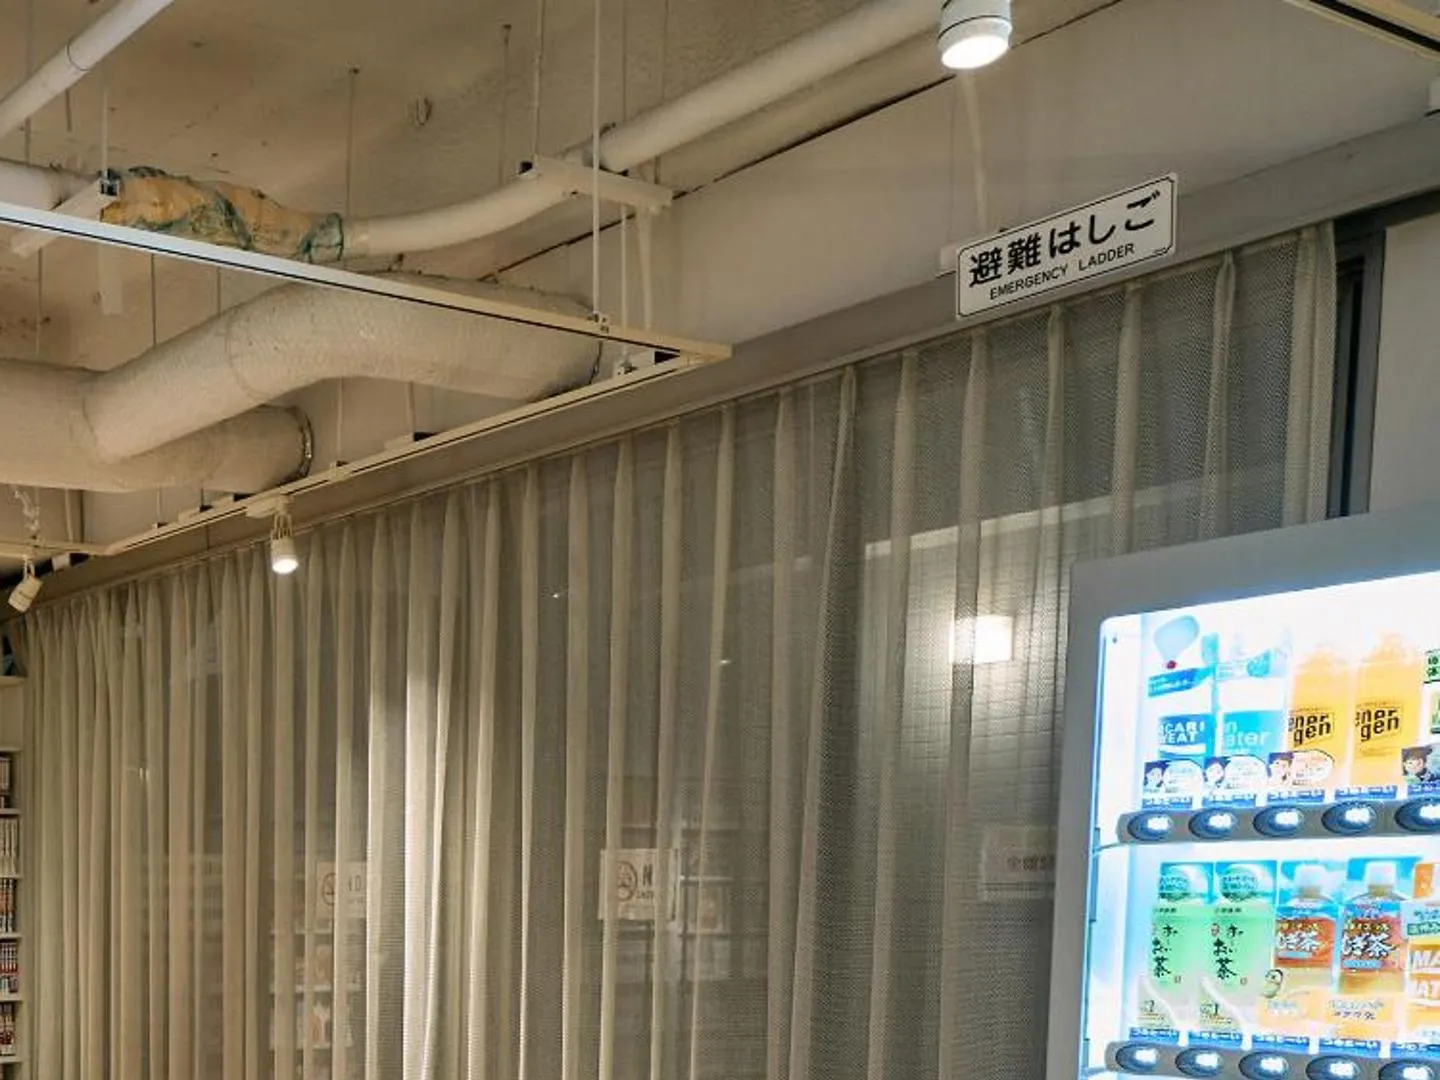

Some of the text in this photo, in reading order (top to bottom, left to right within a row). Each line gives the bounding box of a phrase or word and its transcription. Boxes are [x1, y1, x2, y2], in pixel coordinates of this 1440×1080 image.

[969, 190, 1161, 288] 避難はしご
[990, 243, 1135, 300] EMERGENCY LADDER
[1293, 722, 1332, 748] gen
[1361, 717, 1400, 743] gen
